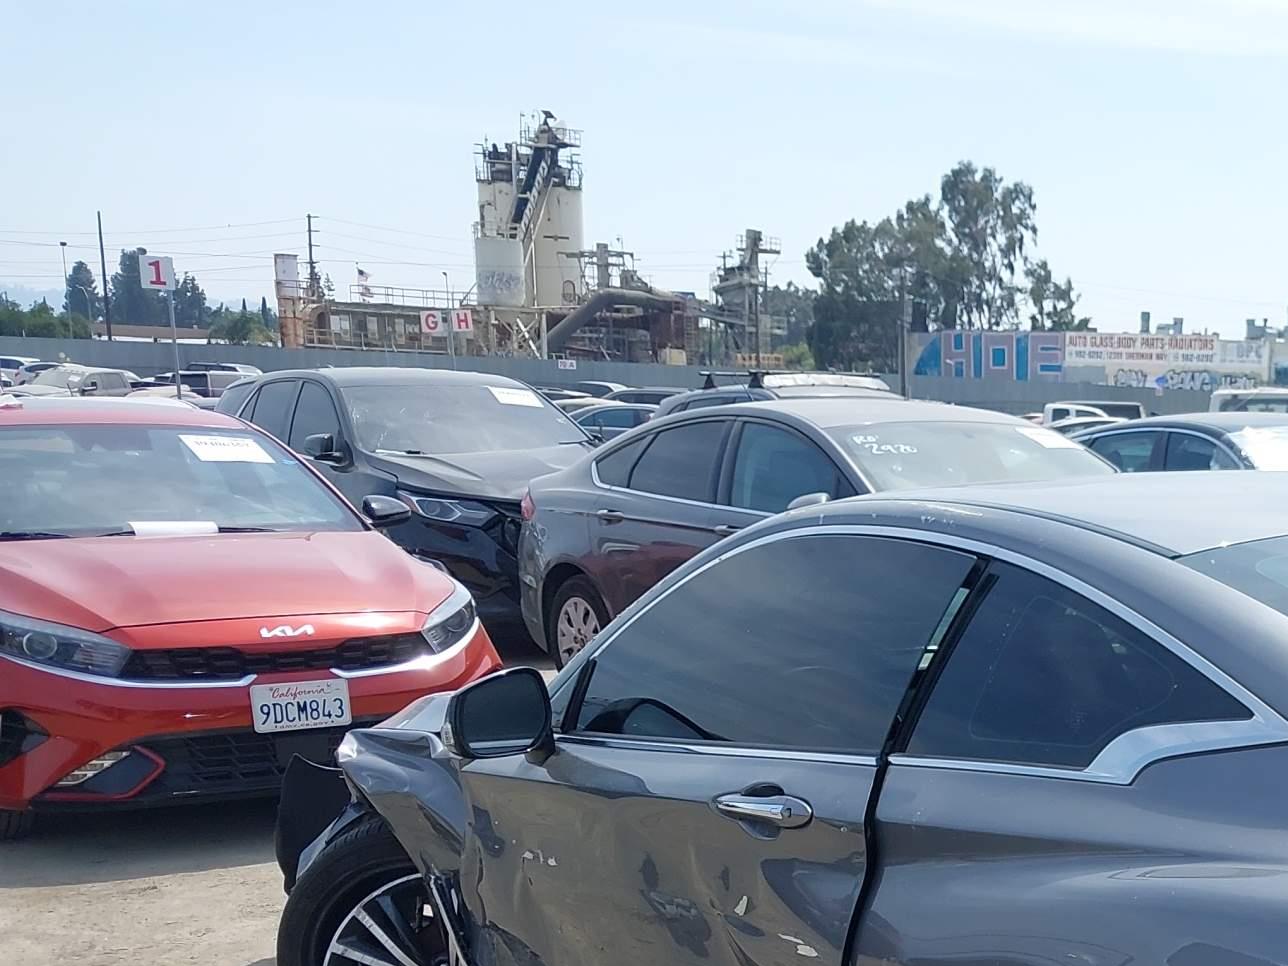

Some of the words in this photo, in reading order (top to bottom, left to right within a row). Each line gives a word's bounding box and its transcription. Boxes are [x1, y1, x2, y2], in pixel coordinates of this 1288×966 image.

[148, 260, 167, 285] 1
[425, 313, 438, 331] G
[456, 312, 469, 330] H
[1068, 335, 1088, 348] AUTO
[272, 686, 326, 701] California
[260, 698, 345, 725] 9DCM843
